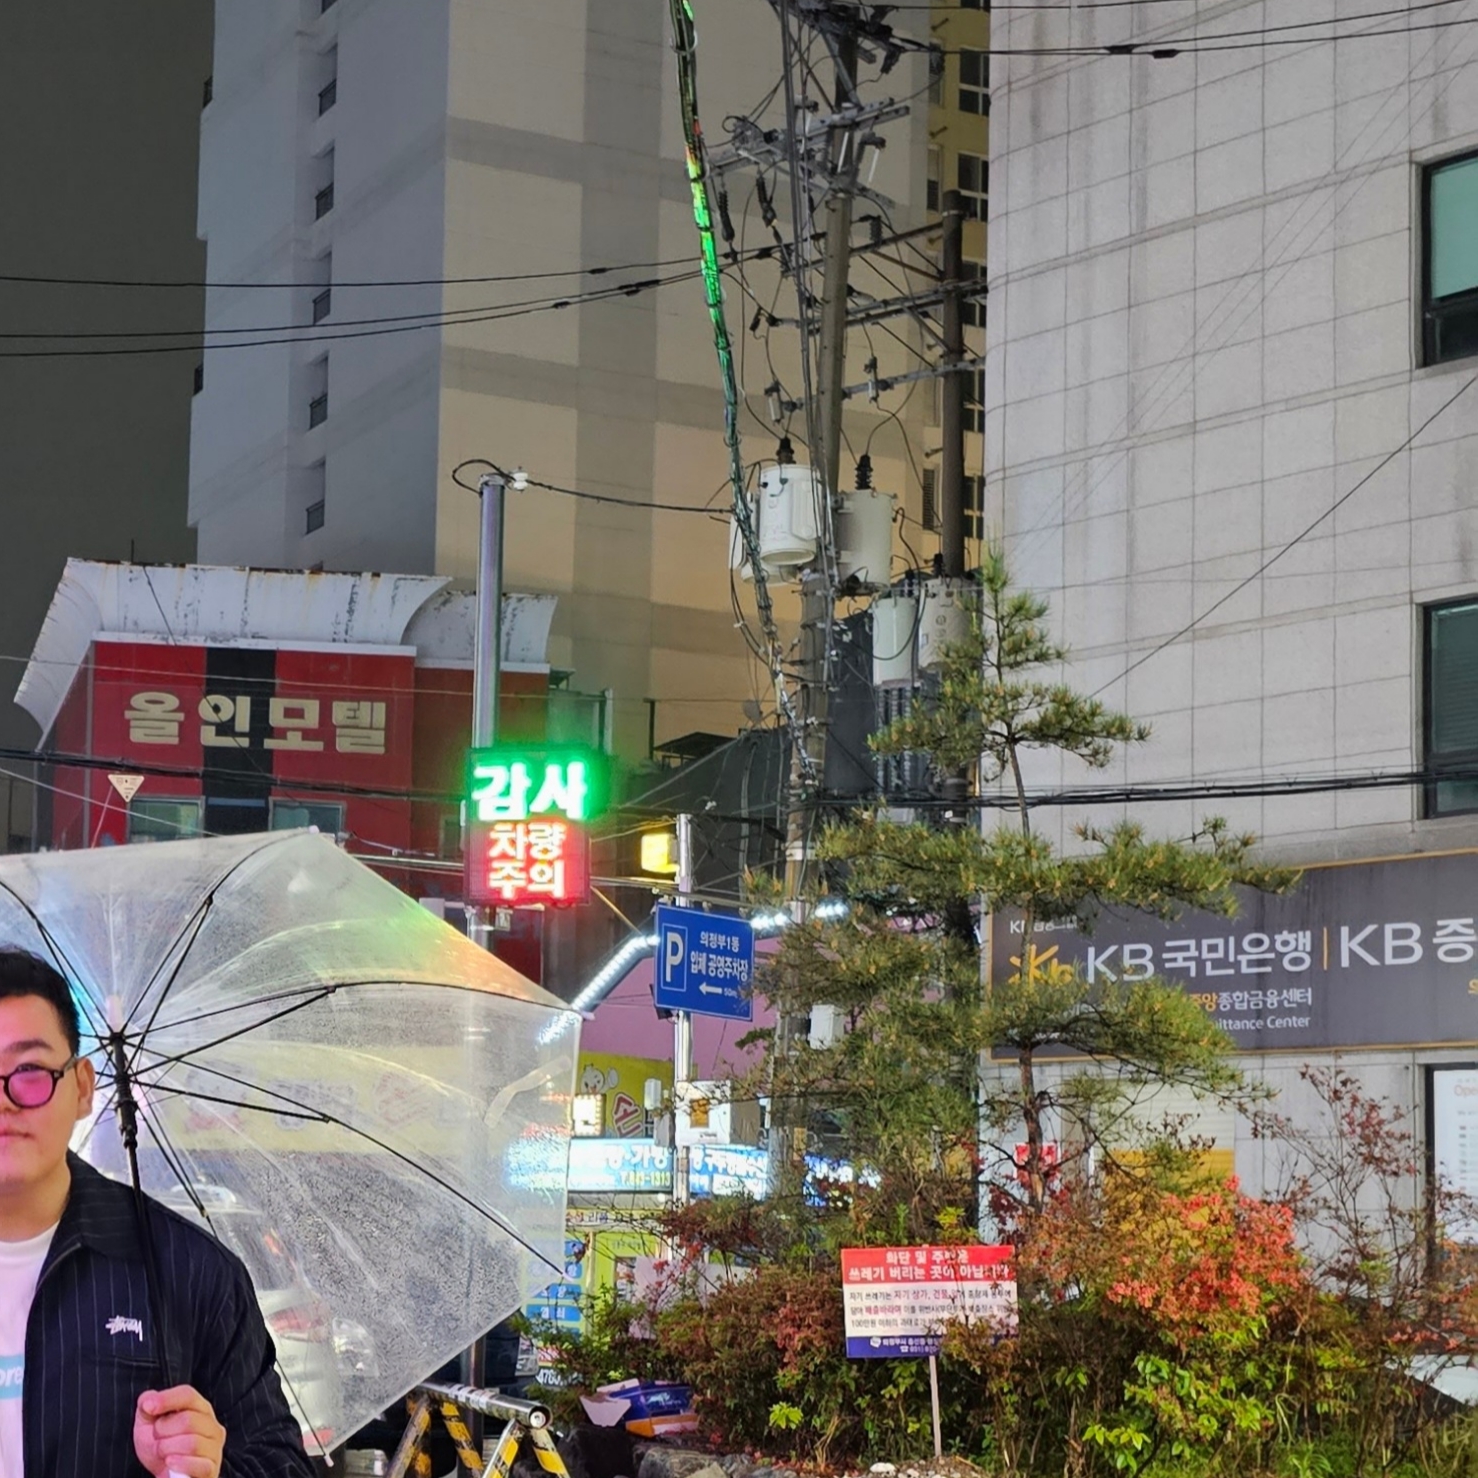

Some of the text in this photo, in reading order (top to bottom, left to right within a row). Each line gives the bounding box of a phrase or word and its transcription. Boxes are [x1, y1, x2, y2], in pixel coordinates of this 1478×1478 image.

[123, 690, 387, 755] 올인모텔
[471, 762, 589, 821] 감사
[489, 822, 567, 860] 차량
[489, 860, 565, 899] 주의
[665, 931, 684, 983] P
[700, 931, 740, 953] 의정부1동
[1161, 929, 1312, 978] 국민은행
[1339, 921, 1424, 969] KB
[690, 951, 749, 982] 입체 공영주차장
[1266, 1015, 1311, 1029] Center
[848, 1266, 885, 1282] 쓰레기
[889, 1265, 926, 1281] 버리는
[885, 1251, 915, 1266] 화단
